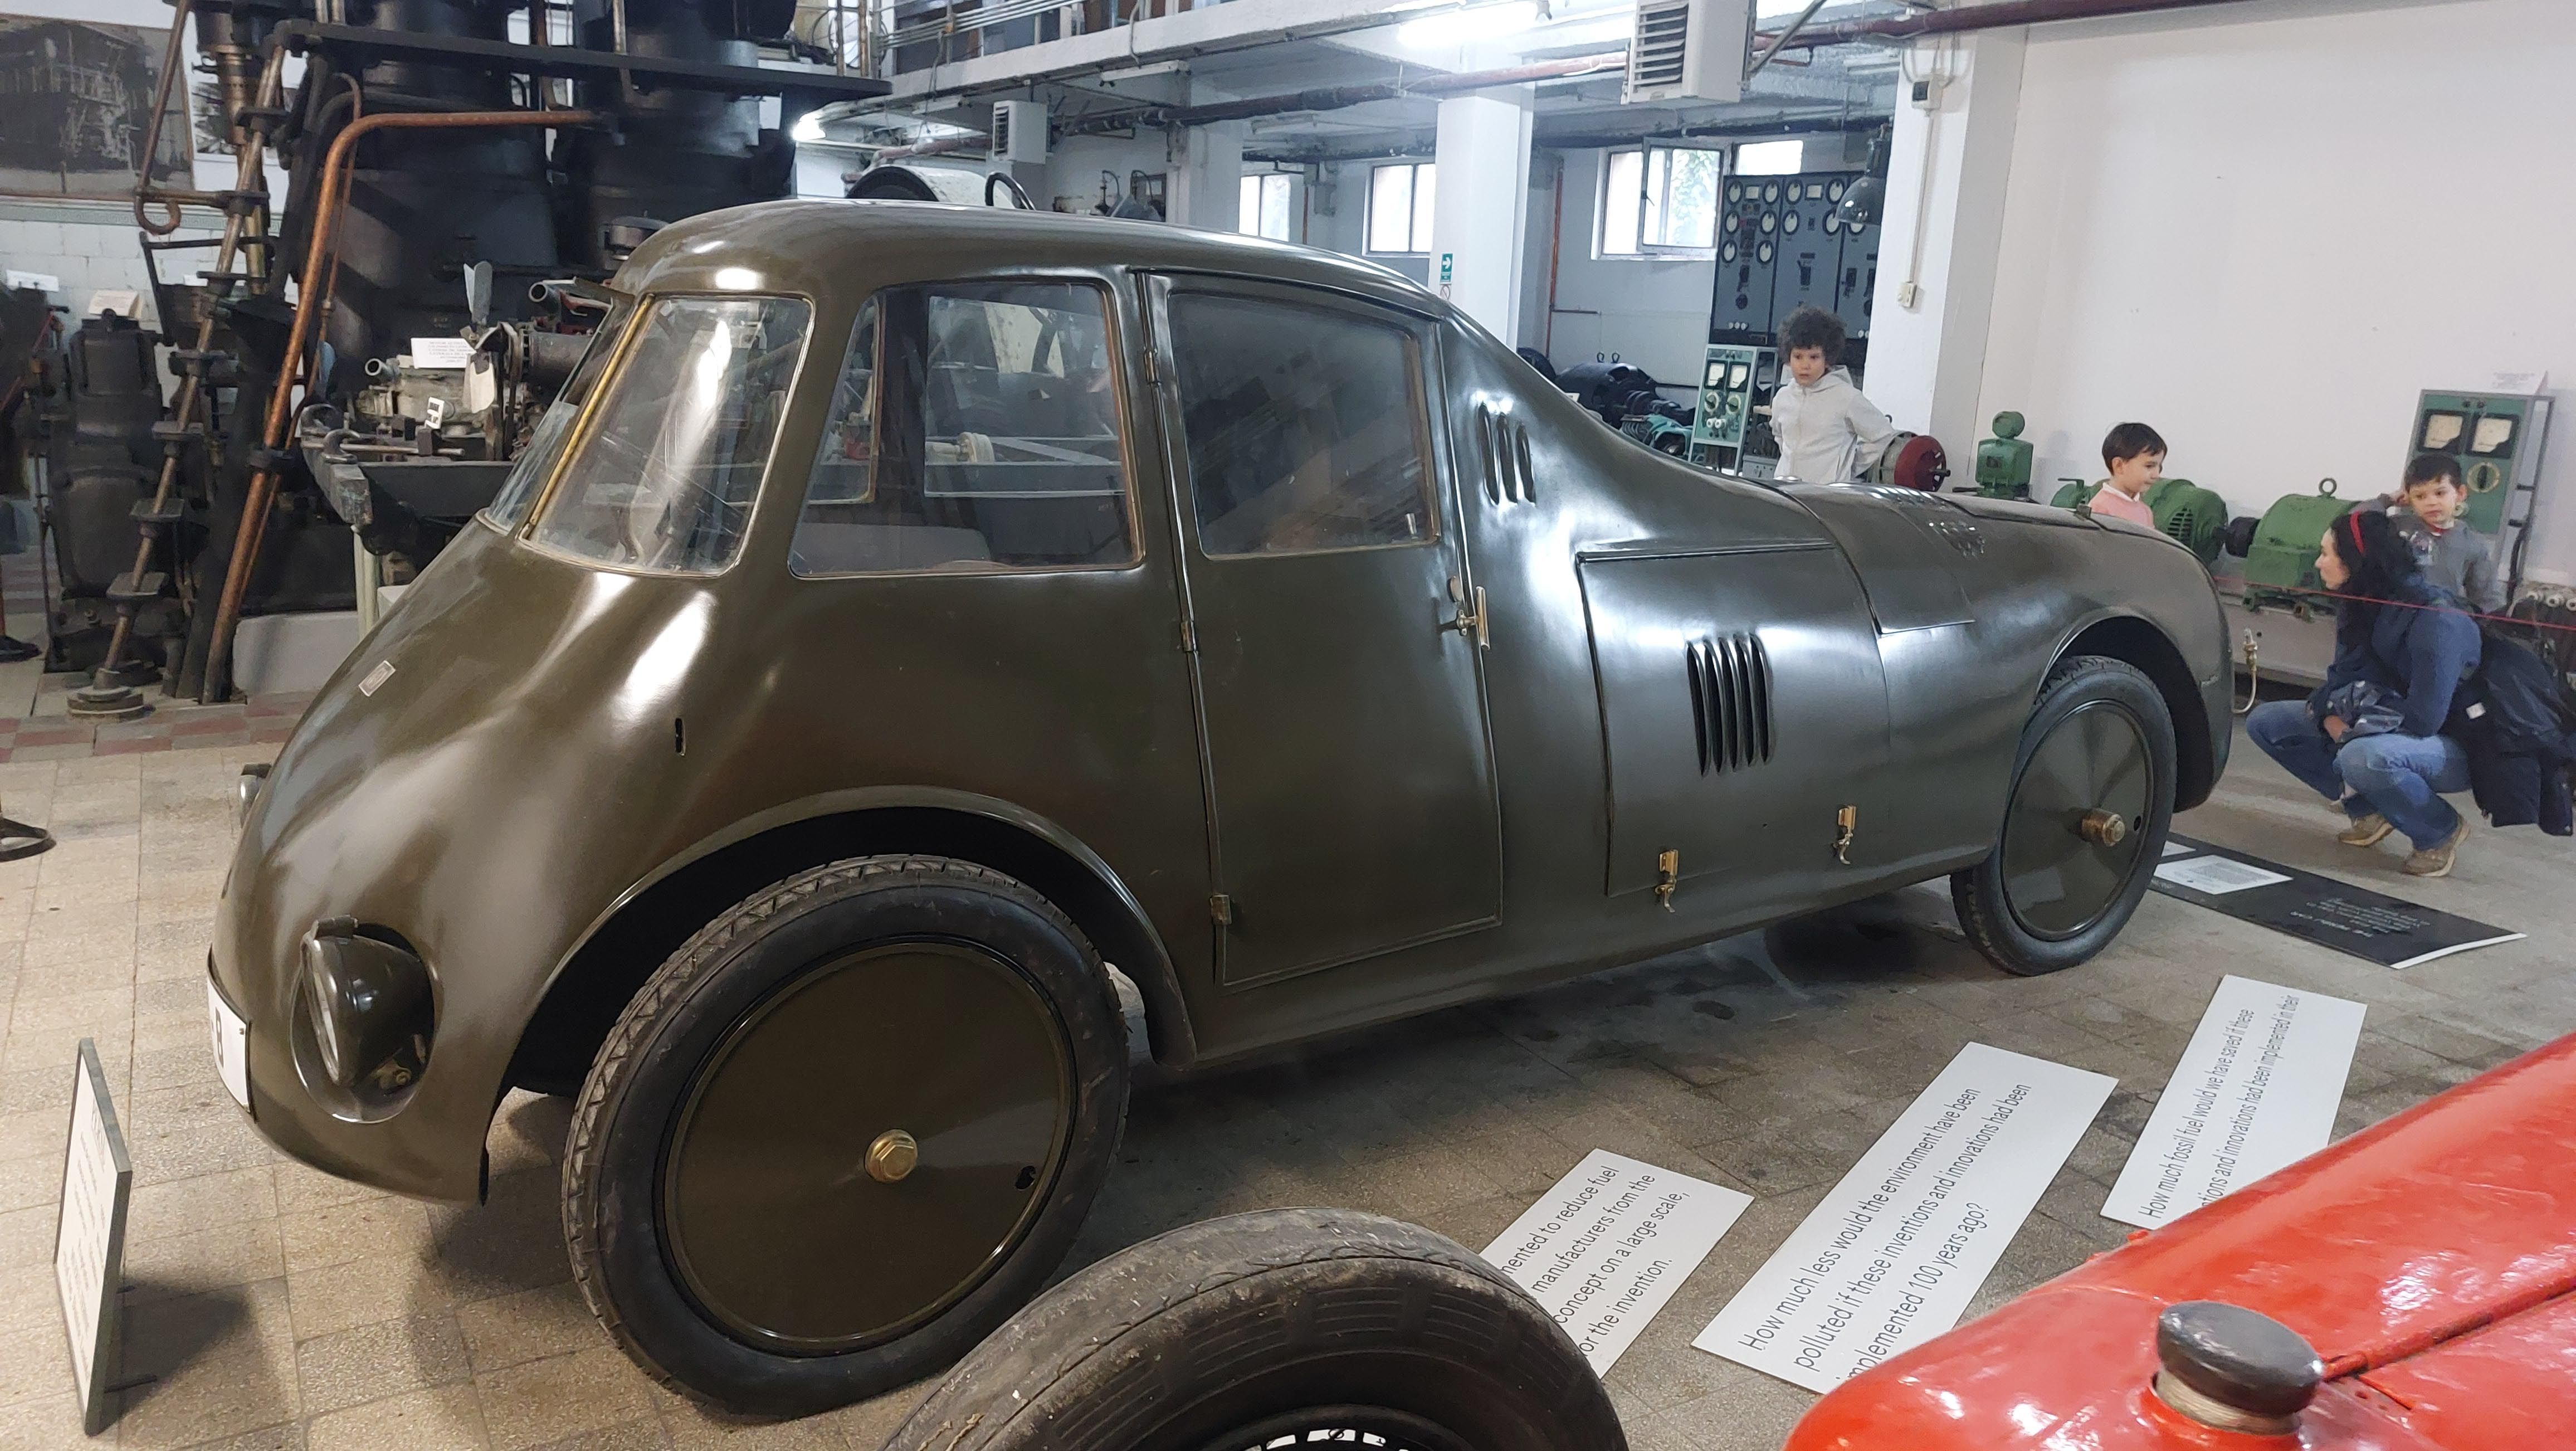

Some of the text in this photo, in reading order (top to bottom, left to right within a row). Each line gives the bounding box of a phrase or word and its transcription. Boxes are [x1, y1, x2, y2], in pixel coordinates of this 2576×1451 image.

[2273, 1011, 2294, 1020] in
[2277, 994, 2300, 1011] their
[2243, 1065, 2272, 1087] been
[2253, 1017, 2291, 1066] implemented
[2138, 1009, 2255, 1219] How much fossil fuel would we have saved if these
[2236, 1084, 2264, 1104] had
[2216, 1103, 2257, 1156] innovations
[1538, 1222, 1562, 1234] to
[1555, 1186, 1599, 1222] reduce
[1587, 1165, 1620, 1186] fuel
[2211, 1153, 2237, 1177] and
[1530, 1175, 1656, 1293] manufacturers from the
[1738, 1088, 1982, 1351] How much less would the environment have been
[1793, 1084, 2032, 1372] polluted if these inventions and innovations had been
[1552, 1192, 1690, 1323] concept on a large scale,
[1835, 1202, 1989, 1380] mplemented 100 years ago?
[1579, 1259, 1672, 1357] or the invention.
